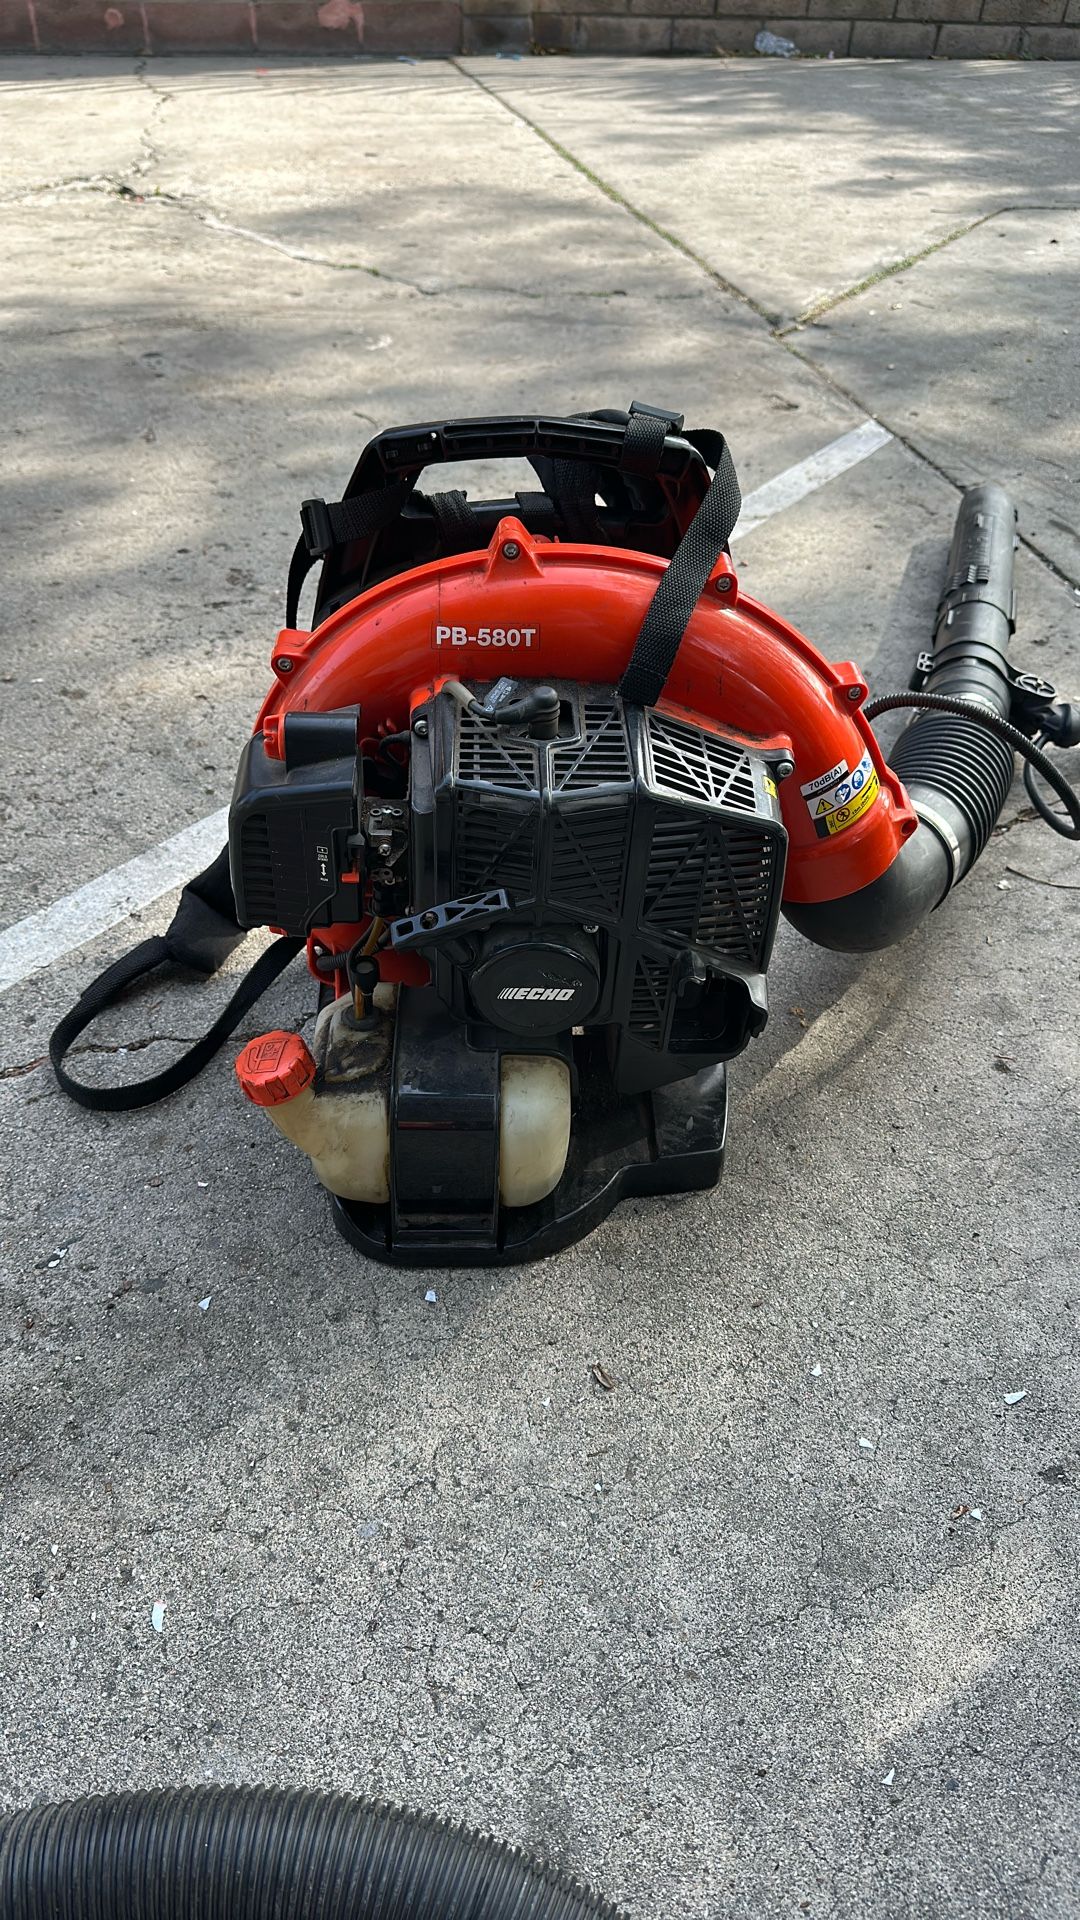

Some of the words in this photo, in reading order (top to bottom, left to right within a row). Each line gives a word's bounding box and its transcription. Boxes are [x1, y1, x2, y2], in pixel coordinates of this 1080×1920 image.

[436, 625, 537, 647] PB-580T
[808, 766, 843, 791] 70dB(A)
[512, 987, 576, 1001] ECHO
